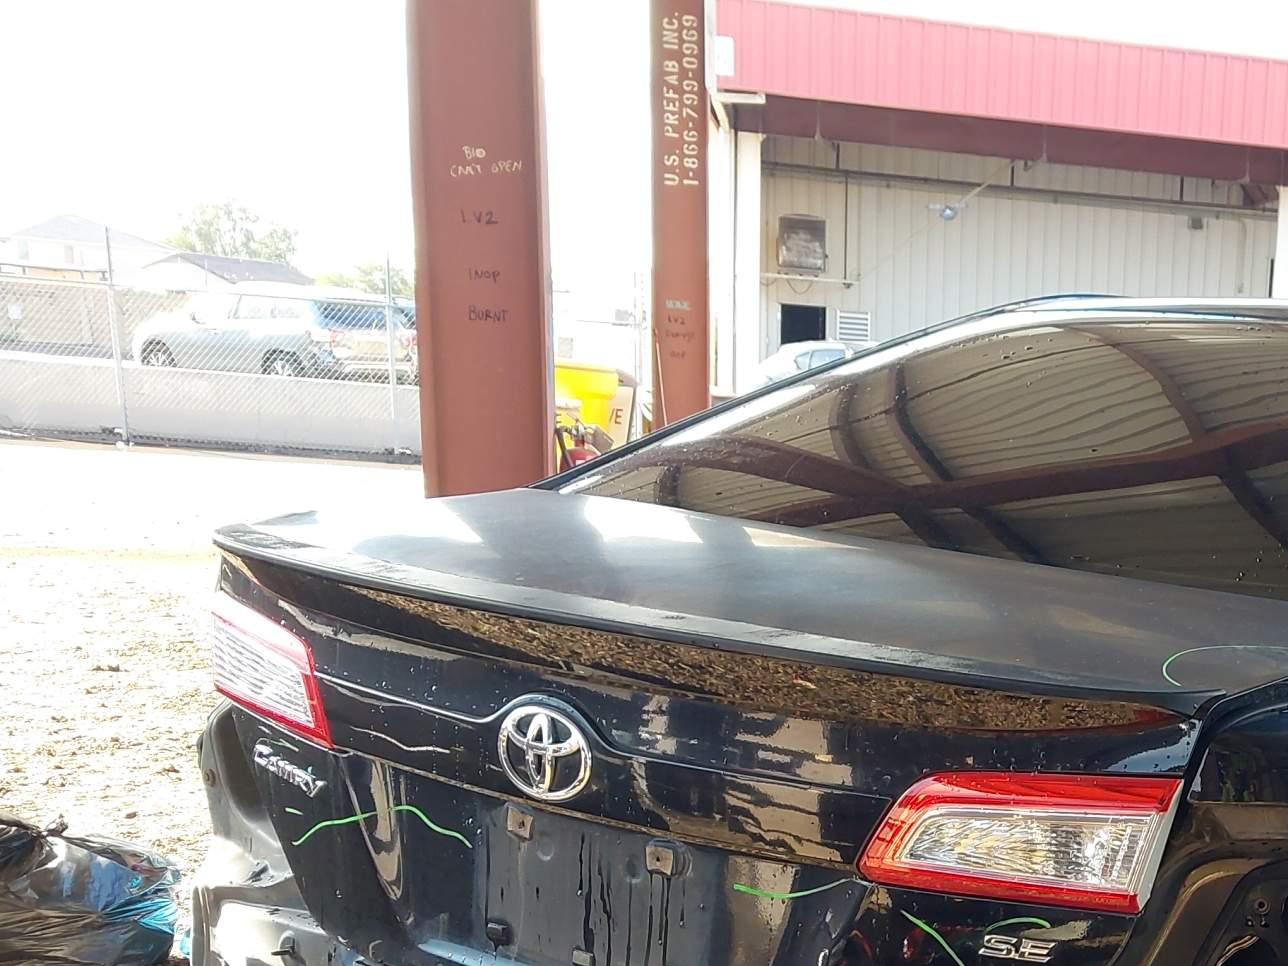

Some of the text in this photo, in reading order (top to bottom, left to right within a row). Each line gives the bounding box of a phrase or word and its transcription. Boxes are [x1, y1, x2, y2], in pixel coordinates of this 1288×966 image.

[662, 11, 680, 186] U.S. PREFAB INC.
[682, 14, 699, 186] 1-866-799-0969
[491, 159, 522, 174] OPEN
[467, 303, 509, 323] BURNT
[253, 743, 328, 798] CAMRY
[978, 934, 1058, 964] SE
